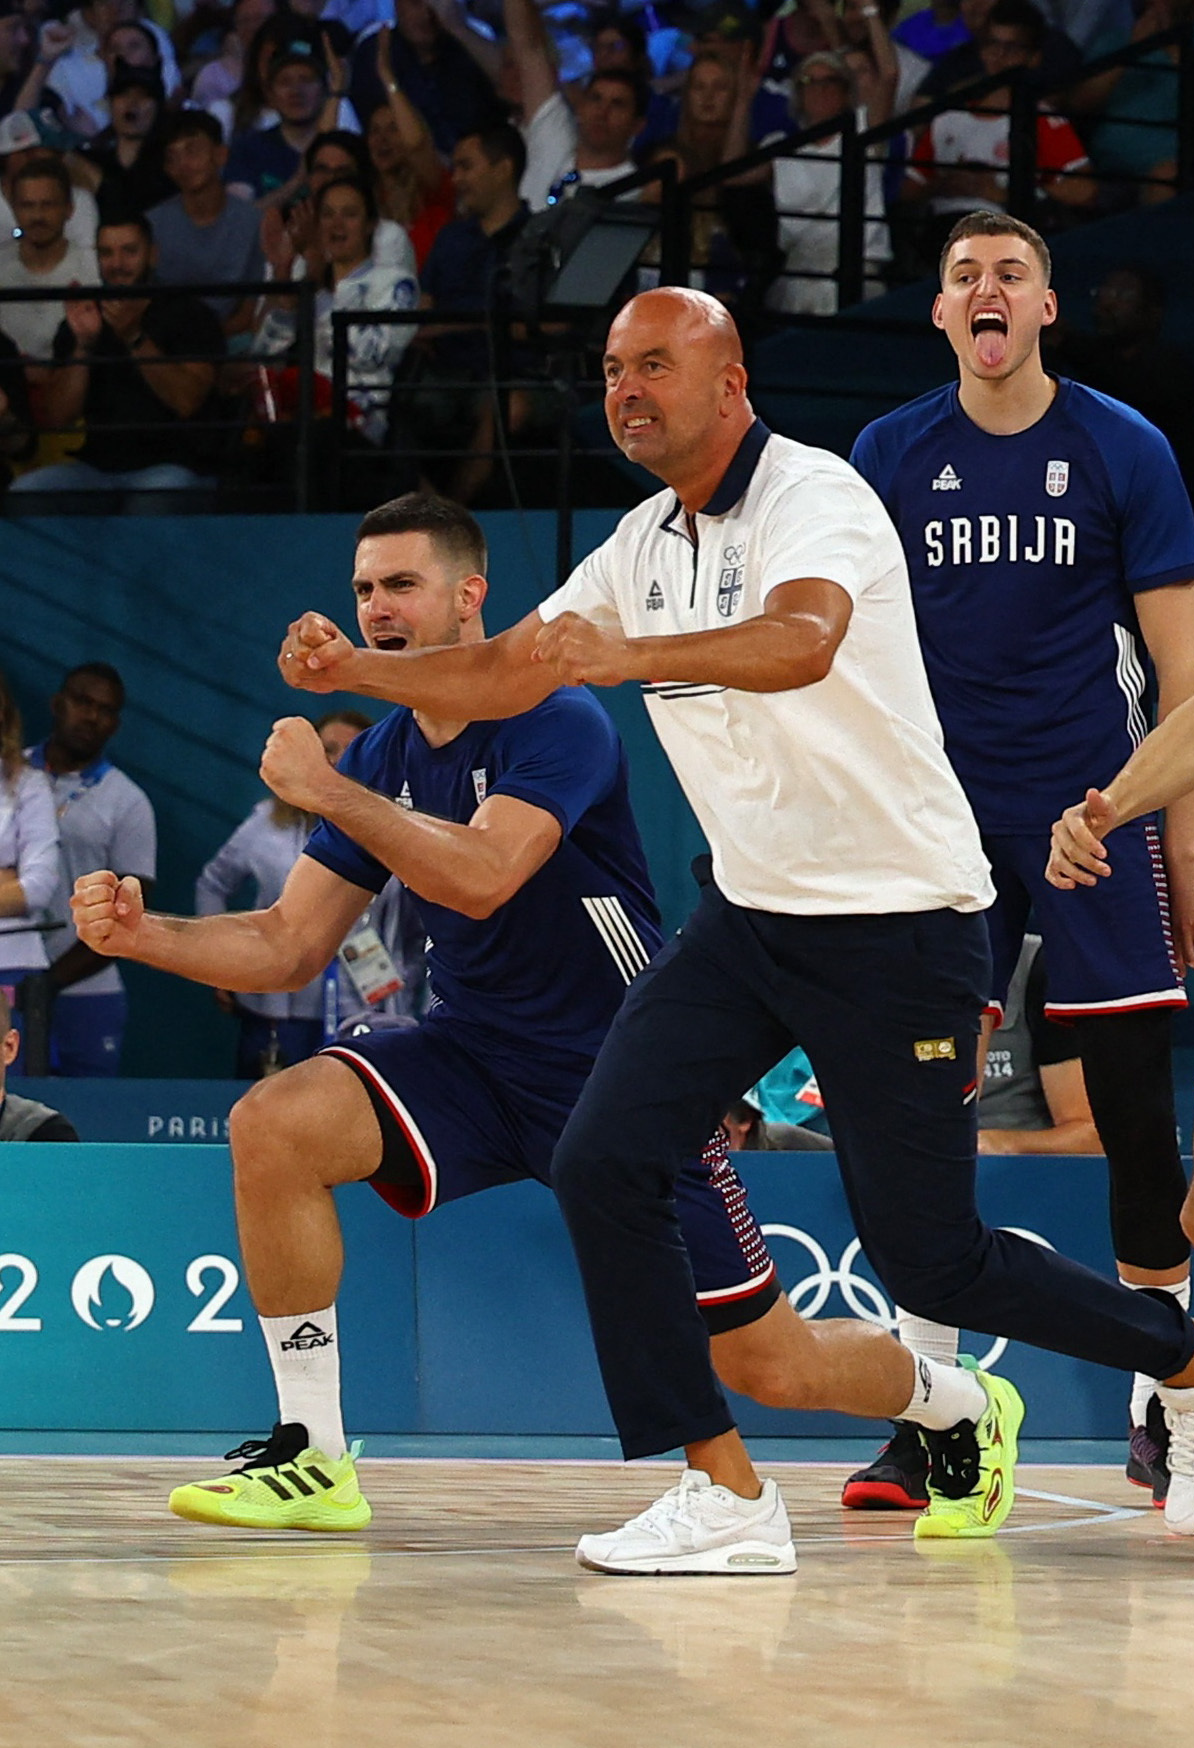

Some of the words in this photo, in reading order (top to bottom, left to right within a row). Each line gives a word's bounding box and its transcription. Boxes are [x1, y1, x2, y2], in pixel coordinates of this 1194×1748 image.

[932, 478, 963, 491] PEAK
[924, 515, 1076, 567] SRBIJA
[986, 1050, 1011, 1062] OTO
[281, 1332, 334, 1352] PEAK
